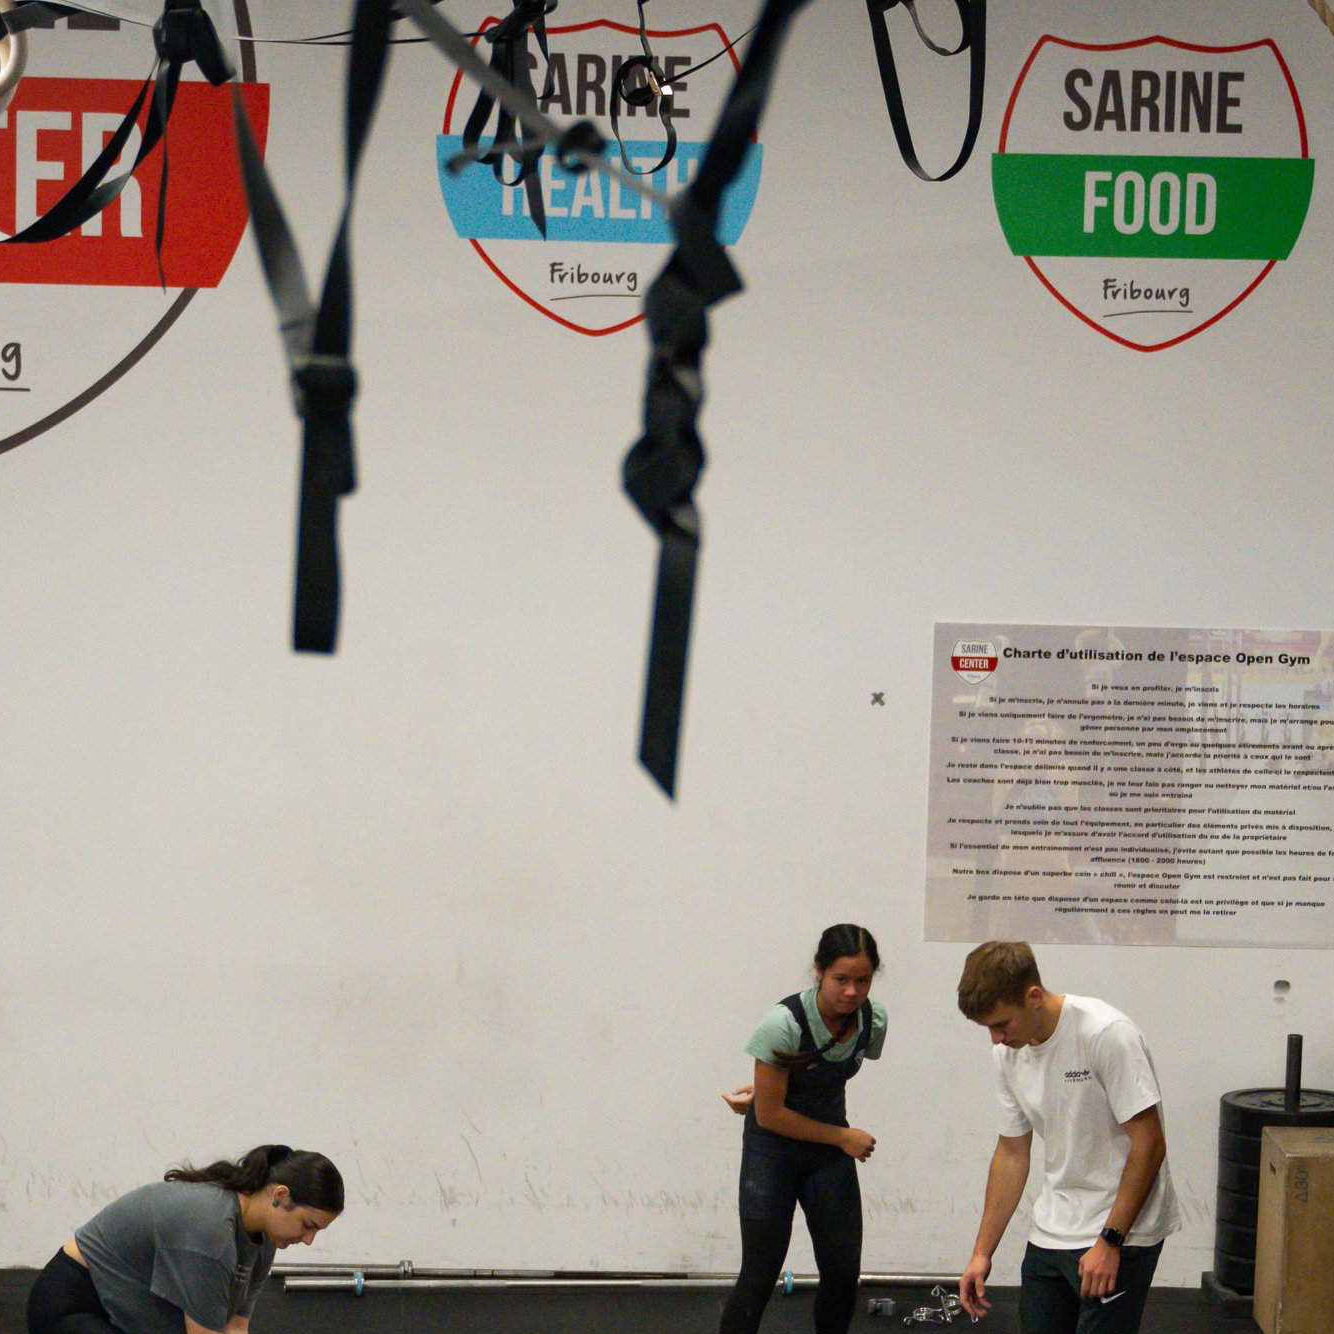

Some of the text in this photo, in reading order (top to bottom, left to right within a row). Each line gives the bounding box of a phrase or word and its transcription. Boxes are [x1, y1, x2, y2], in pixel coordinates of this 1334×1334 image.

[1064, 68, 1244, 134] SARINE
[1083, 171, 1217, 235] FOOD
[549, 262, 638, 291] Fribourg
[1101, 279, 1192, 307] Fribourg
[961, 644, 989, 654] SARINE
[1003, 647, 1311, 666] Charte d'utilisation de l'espace Open Gym
[959, 658, 989, 669] CENTER
[1091, 699, 1105, 707] pas
[1238, 701, 1273, 710] respecte
[1288, 702, 1320, 710] horaires
[1000, 711, 1046, 720] uniquement
[1152, 715, 1166, 723] pas
[1168, 714, 1194, 722] besoin
[1104, 725, 1140, 733] personne
[1175, 725, 1227, 734] emplacement
[1093, 804, 1123, 812] classes
[1144, 805, 1186, 814] prioritaires
[1188, 807, 1206, 815] pour
[1128, 856, 1150, 864] (1800
[1156, 856, 1175, 864] 2000
[1177, 857, 1206, 865] heures)
[1170, 908, 1188, 916] peut
[1212, 908, 1237, 916] retirer
